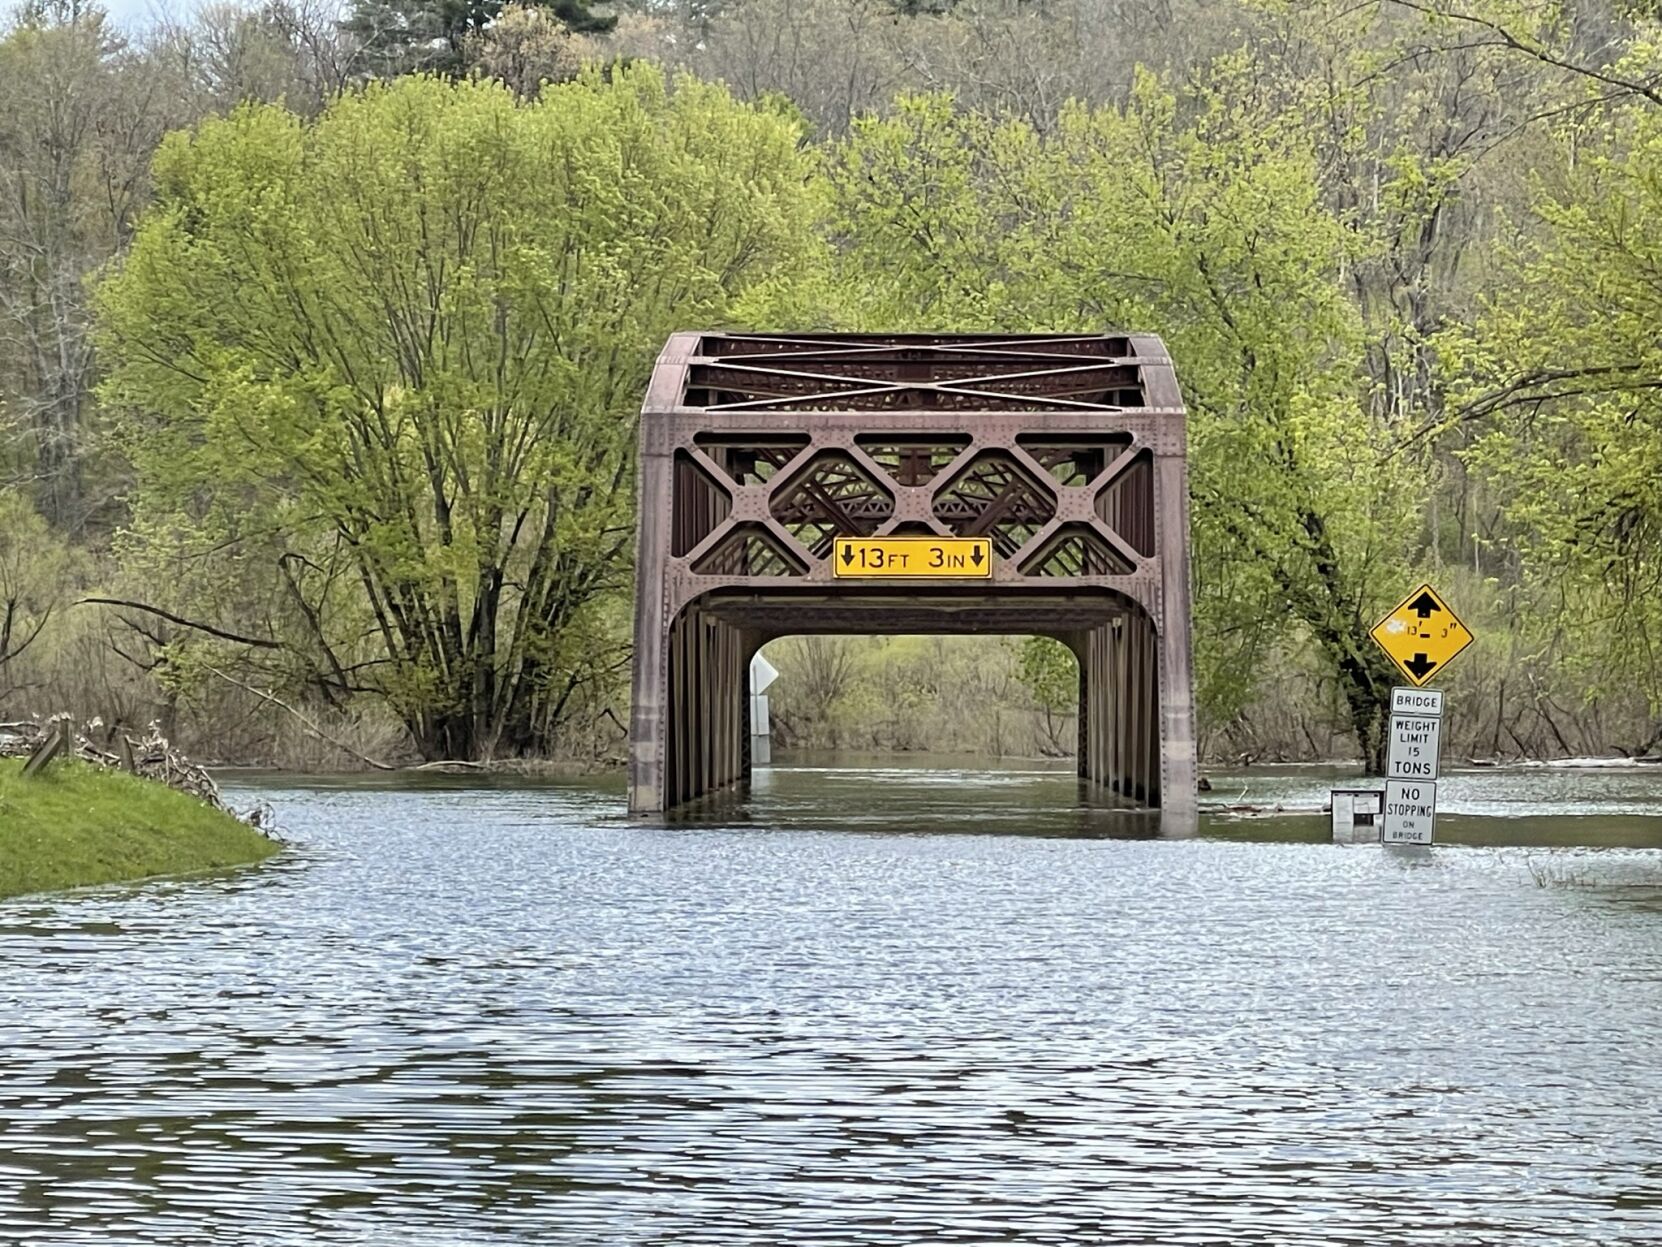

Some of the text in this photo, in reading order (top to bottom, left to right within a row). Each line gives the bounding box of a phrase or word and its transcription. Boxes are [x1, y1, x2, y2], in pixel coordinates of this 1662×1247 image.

[1396, 695, 1437, 708] BRIDGE
[1396, 720, 1437, 732] WEIGHT
[1400, 733, 1429, 744] LIMIT
[1408, 746, 1420, 757] 15
[1395, 761, 1431, 775] TONS
[1401, 787, 1420, 800] NO
[1387, 803, 1432, 817] STOPPING
[1402, 820, 1415, 829] ON
[1392, 831, 1423, 840] BRIDGE
